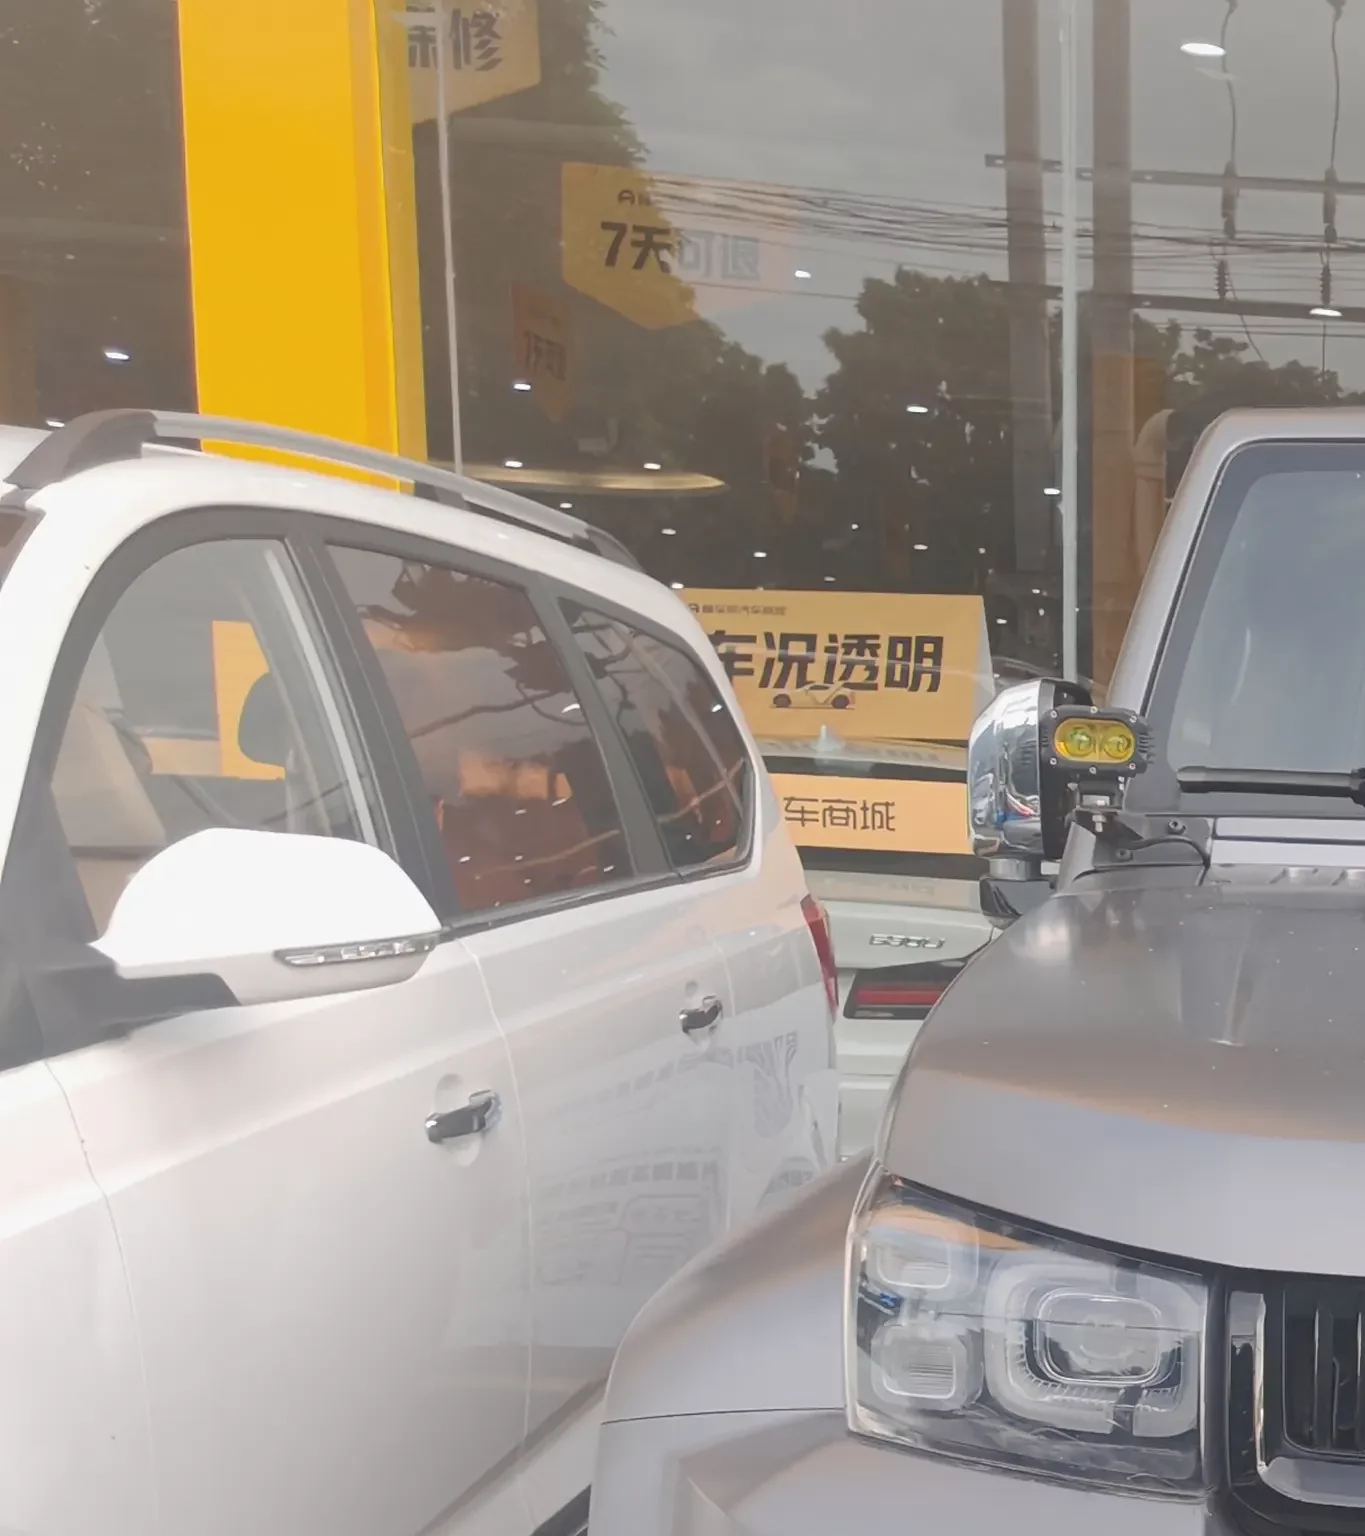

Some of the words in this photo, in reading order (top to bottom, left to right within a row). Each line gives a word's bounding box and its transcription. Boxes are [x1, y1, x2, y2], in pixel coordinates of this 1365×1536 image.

[705, 629, 944, 692] 车况透明
[783, 796, 897, 832] 车商城
